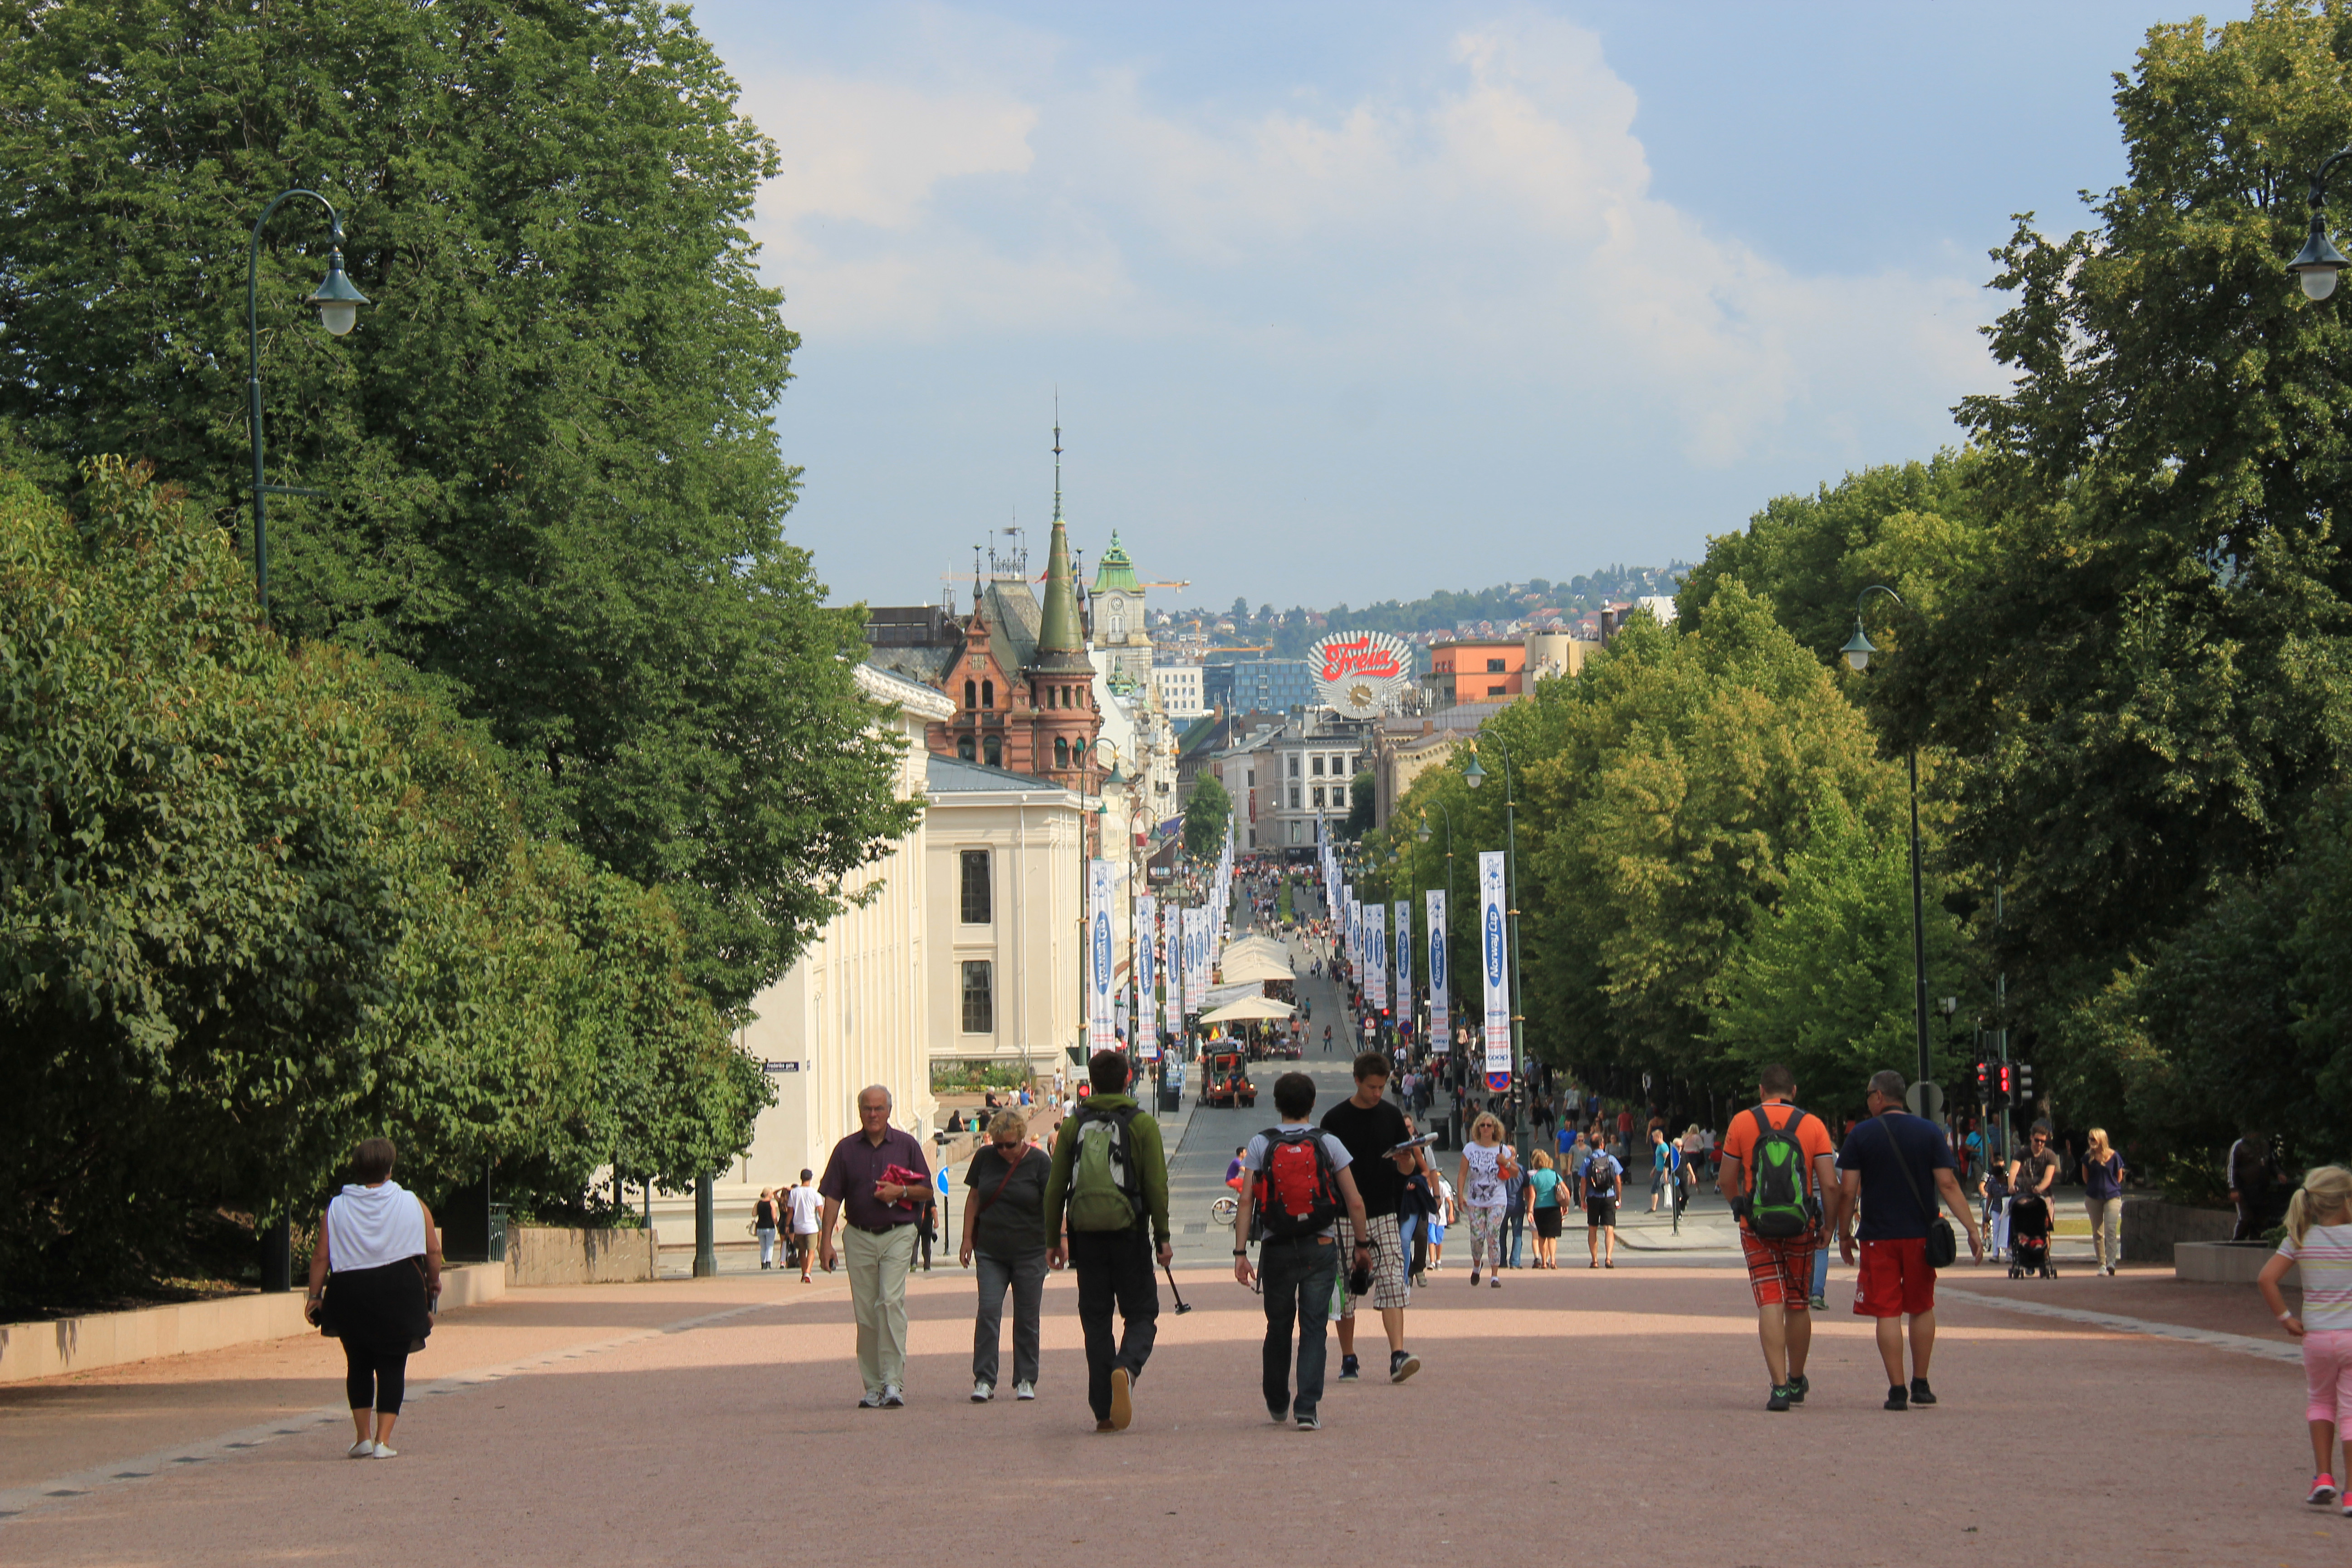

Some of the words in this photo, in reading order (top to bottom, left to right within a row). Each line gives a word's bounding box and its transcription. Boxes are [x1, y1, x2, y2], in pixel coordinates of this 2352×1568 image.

[1323, 637, 1400, 681] Freia
[1489, 911, 1498, 933] Cup
[1490, 934, 1499, 978] Norway
